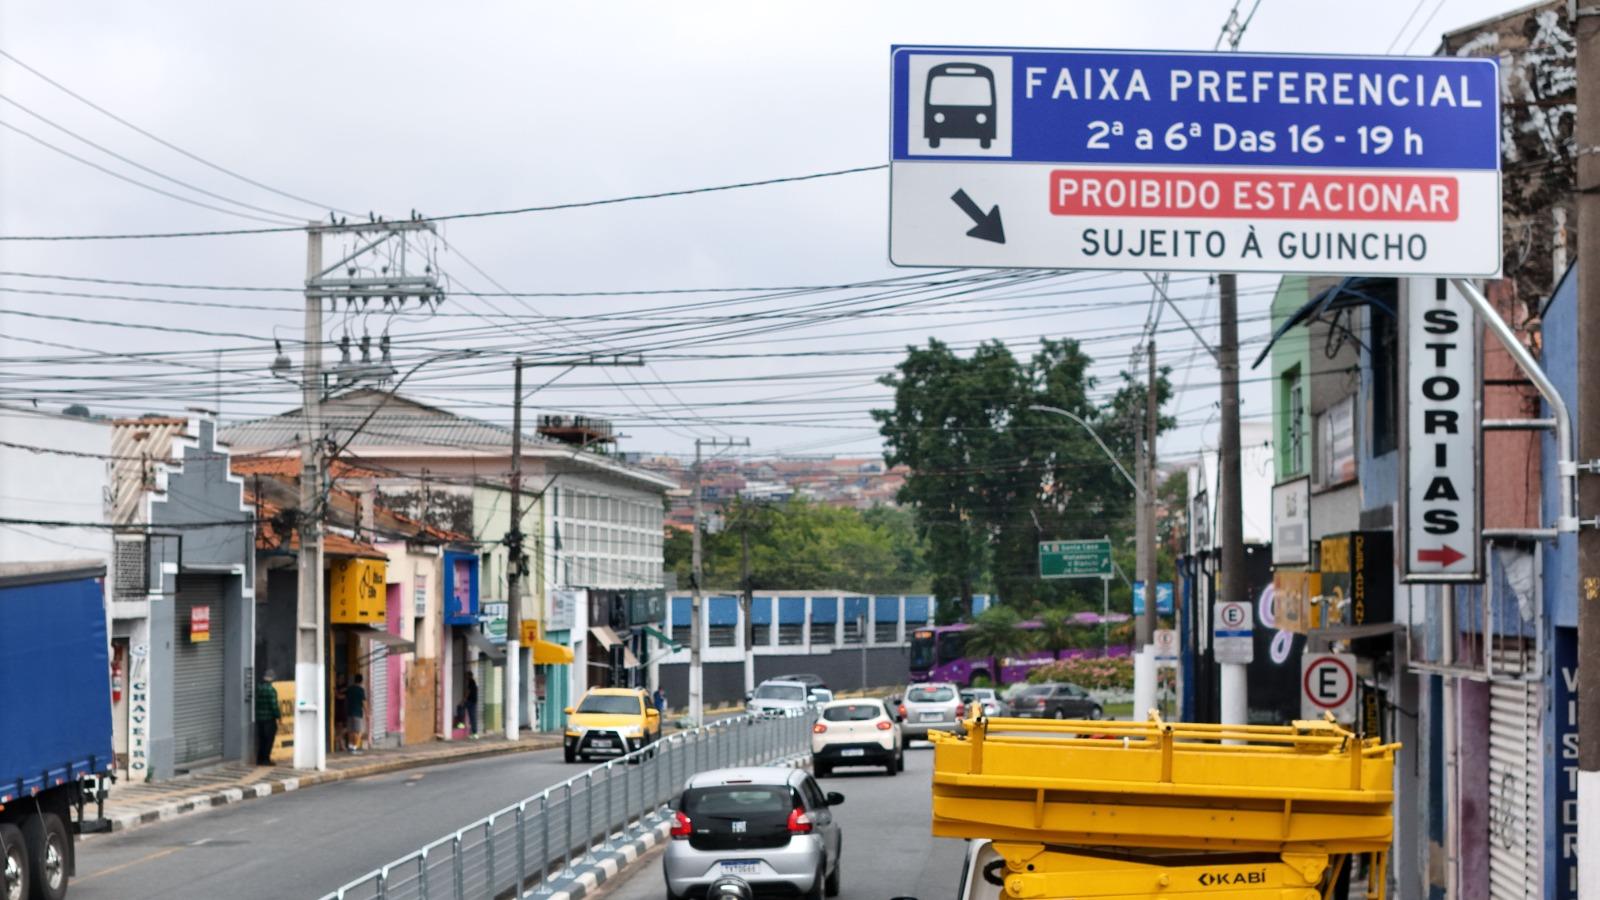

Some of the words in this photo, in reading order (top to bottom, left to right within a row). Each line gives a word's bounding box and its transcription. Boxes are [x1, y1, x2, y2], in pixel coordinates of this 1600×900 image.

[1025, 67, 1151, 101] FAIXA
[1171, 70, 1482, 107] PREFERENCIAL
[1087, 121, 1124, 150] 2ª
[1135, 130, 1154, 150] a
[1164, 122, 1201, 151] 6ª
[1214, 123, 1276, 152] Das
[1289, 125, 1324, 153] 16
[1358, 125, 1397, 154] 19
[1405, 125, 1424, 155] h
[1058, 178, 1220, 209] PROIBIDO
[1234, 181, 1450, 213] ESTACIONAR
[1081, 229, 1226, 258] SUJEITO
[1241, 224, 1263, 258] À
[1278, 231, 1427, 260] GUINCHO
[1228, 609, 1238, 622] E
[1319, 667, 1337, 698] E
[132, 683, 146, 769] CHAVEIRO
